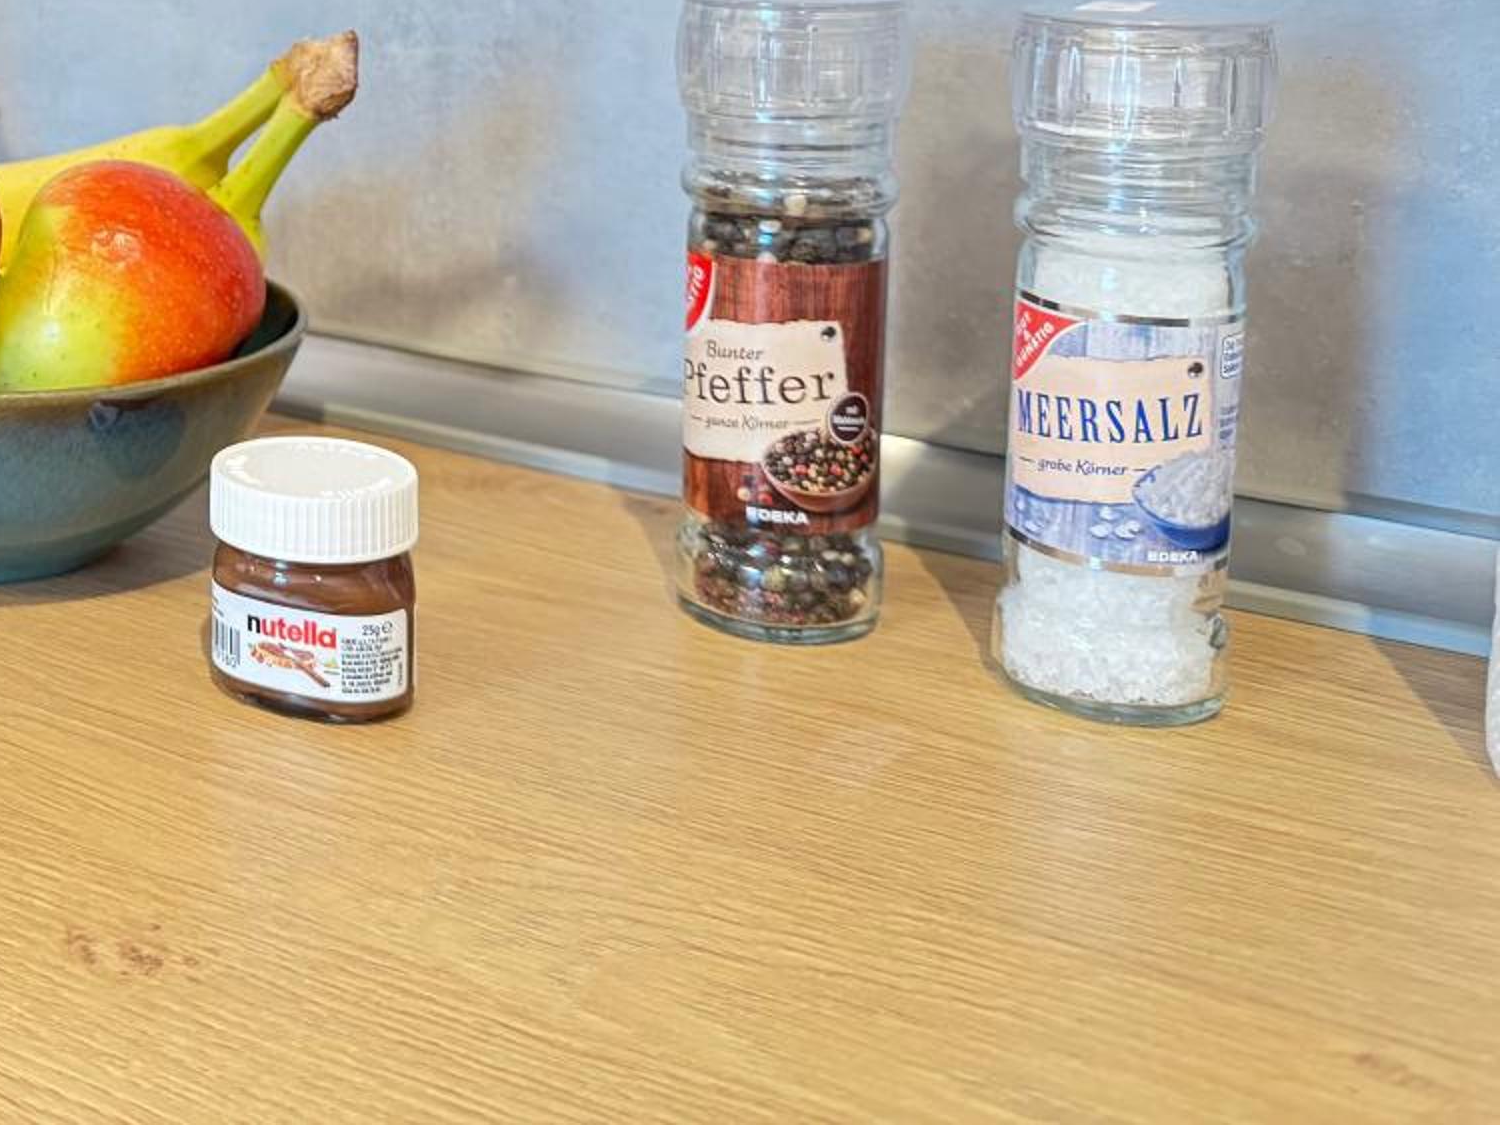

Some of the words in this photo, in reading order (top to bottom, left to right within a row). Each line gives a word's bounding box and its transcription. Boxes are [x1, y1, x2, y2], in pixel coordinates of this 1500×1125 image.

[706, 339, 764, 361] Bunter
[1017, 389, 1203, 444] MEERSALZ
[1037, 458, 1073, 474] grobe
[1075, 461, 1127, 477] Körner
[247, 614, 336, 649] nutella
